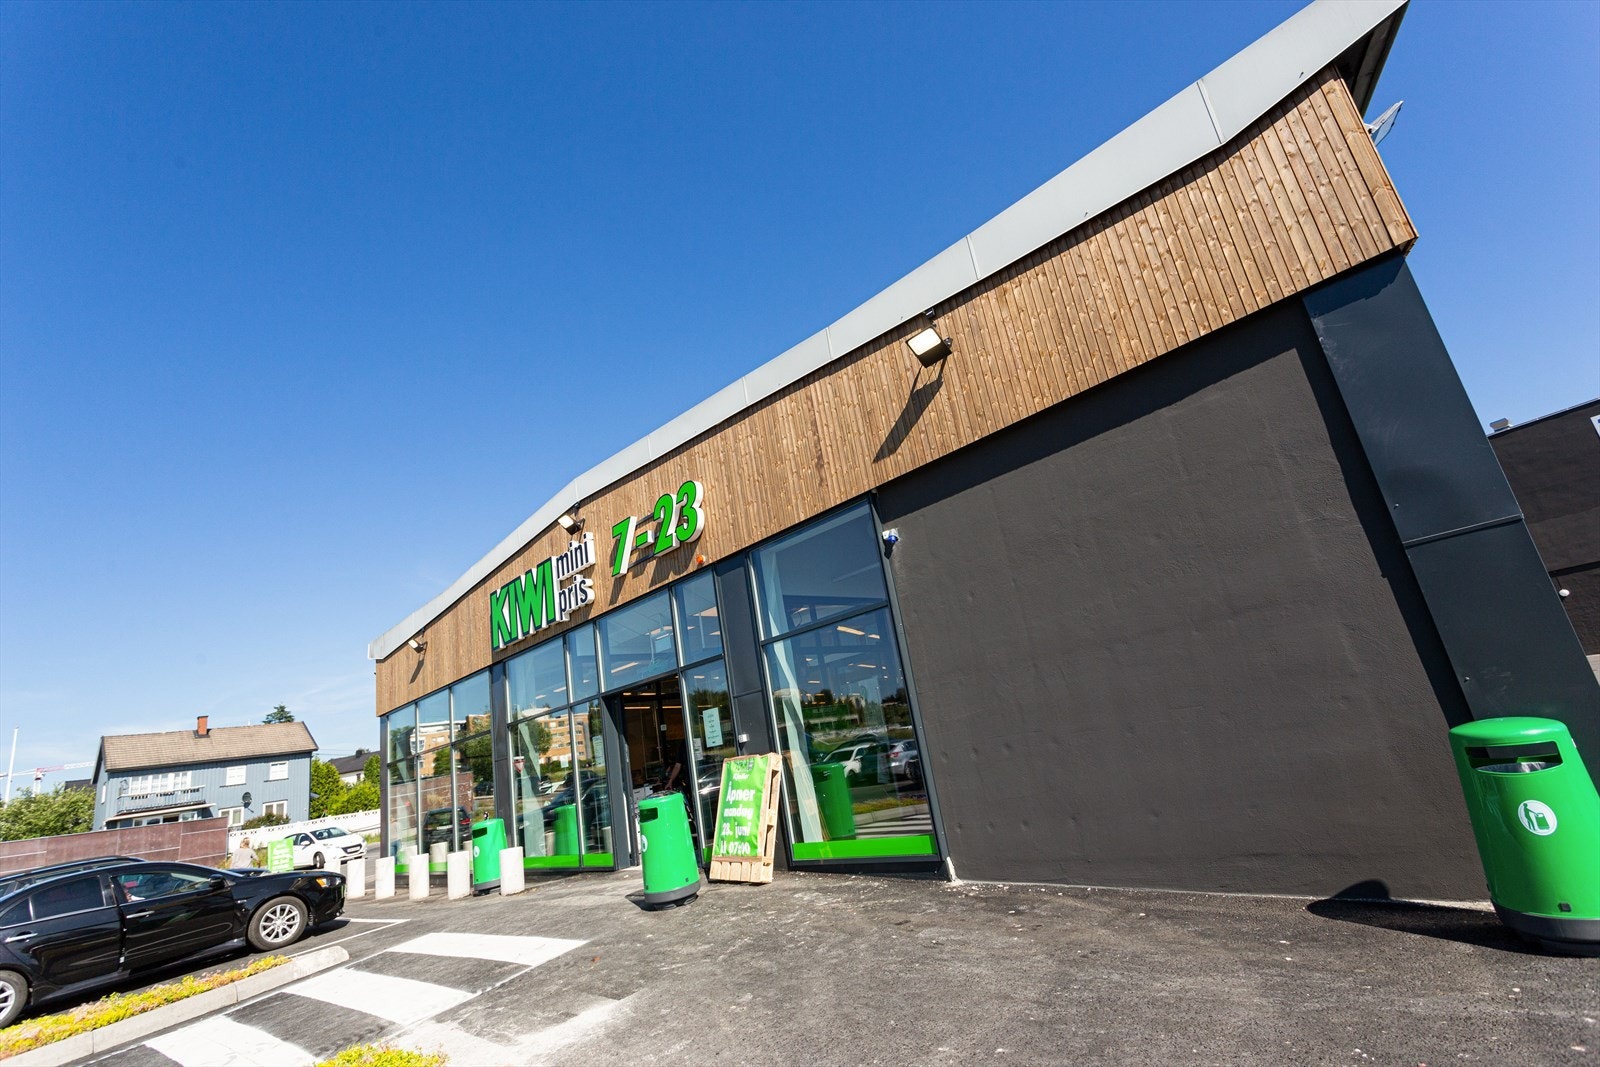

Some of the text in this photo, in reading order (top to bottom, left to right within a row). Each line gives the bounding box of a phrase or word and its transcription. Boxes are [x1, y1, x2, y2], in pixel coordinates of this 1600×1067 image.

[612, 480, 701, 577] 7-23
[556, 533, 591, 579] mini
[490, 556, 558, 650] KIWI
[558, 575, 591, 620] pris
[726, 781, 756, 804] Åpner
[735, 821, 752, 839] juni
